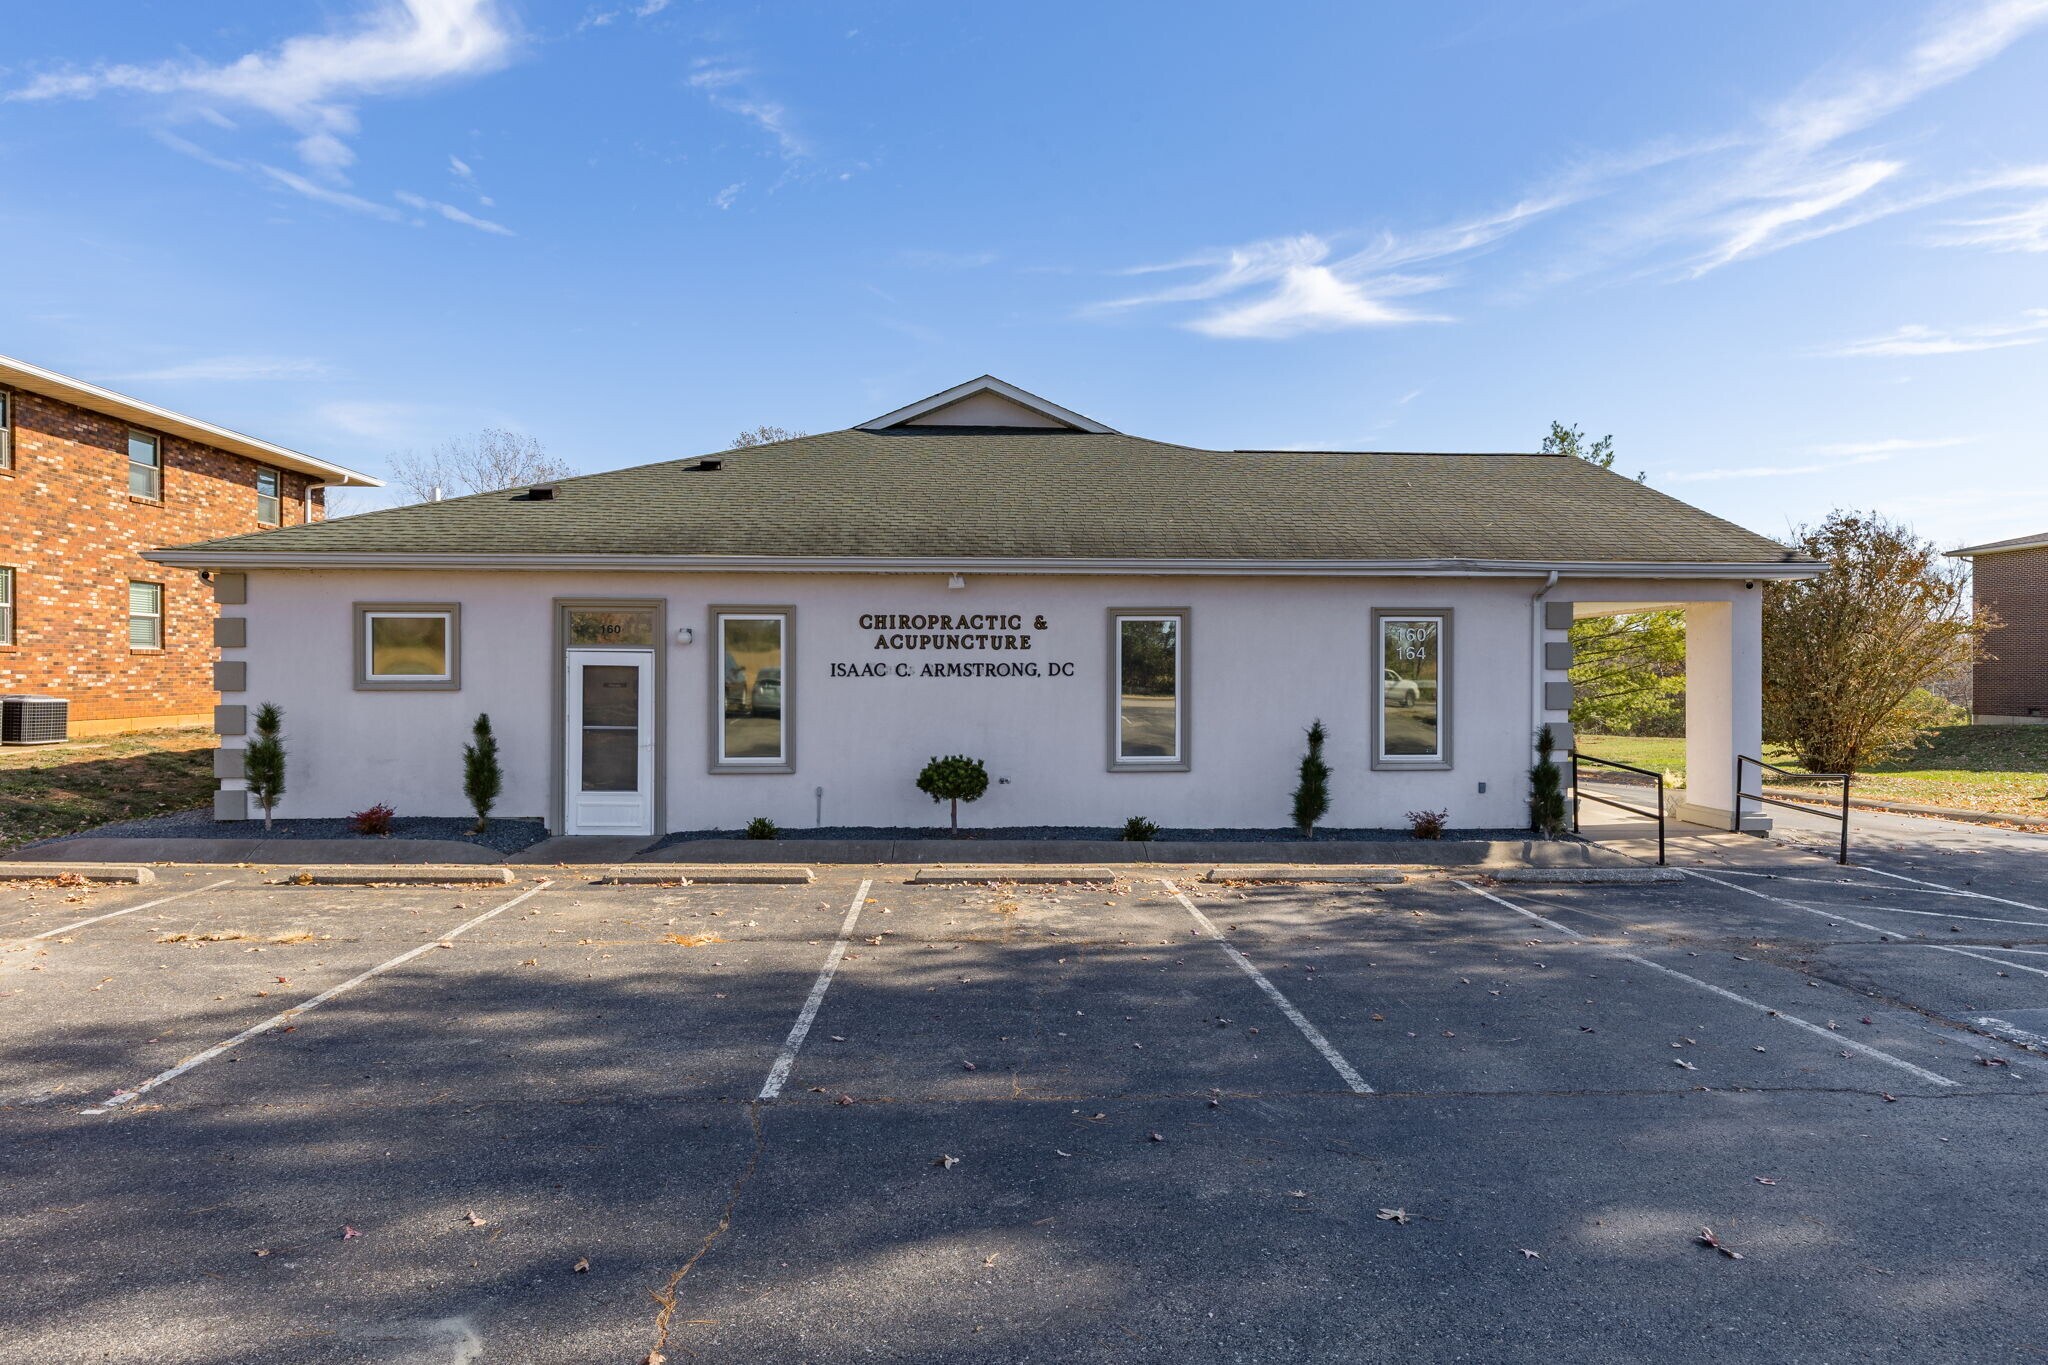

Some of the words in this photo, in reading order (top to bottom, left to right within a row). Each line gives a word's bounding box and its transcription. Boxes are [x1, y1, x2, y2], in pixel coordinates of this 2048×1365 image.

[601, 625, 621, 634] 160
[859, 614, 1022, 630] CHIROPRACTIC
[1033, 614, 1048, 630] &
[874, 634, 1032, 650] ACUPUNCTURE
[1398, 628, 1426, 642] 160
[1396, 646, 1426, 660] 164
[830, 662, 886, 677] ISAAC
[895, 662, 911, 677] C.
[920, 662, 1041, 678] ARMSTRONG,
[1048, 662, 1074, 677] DC
